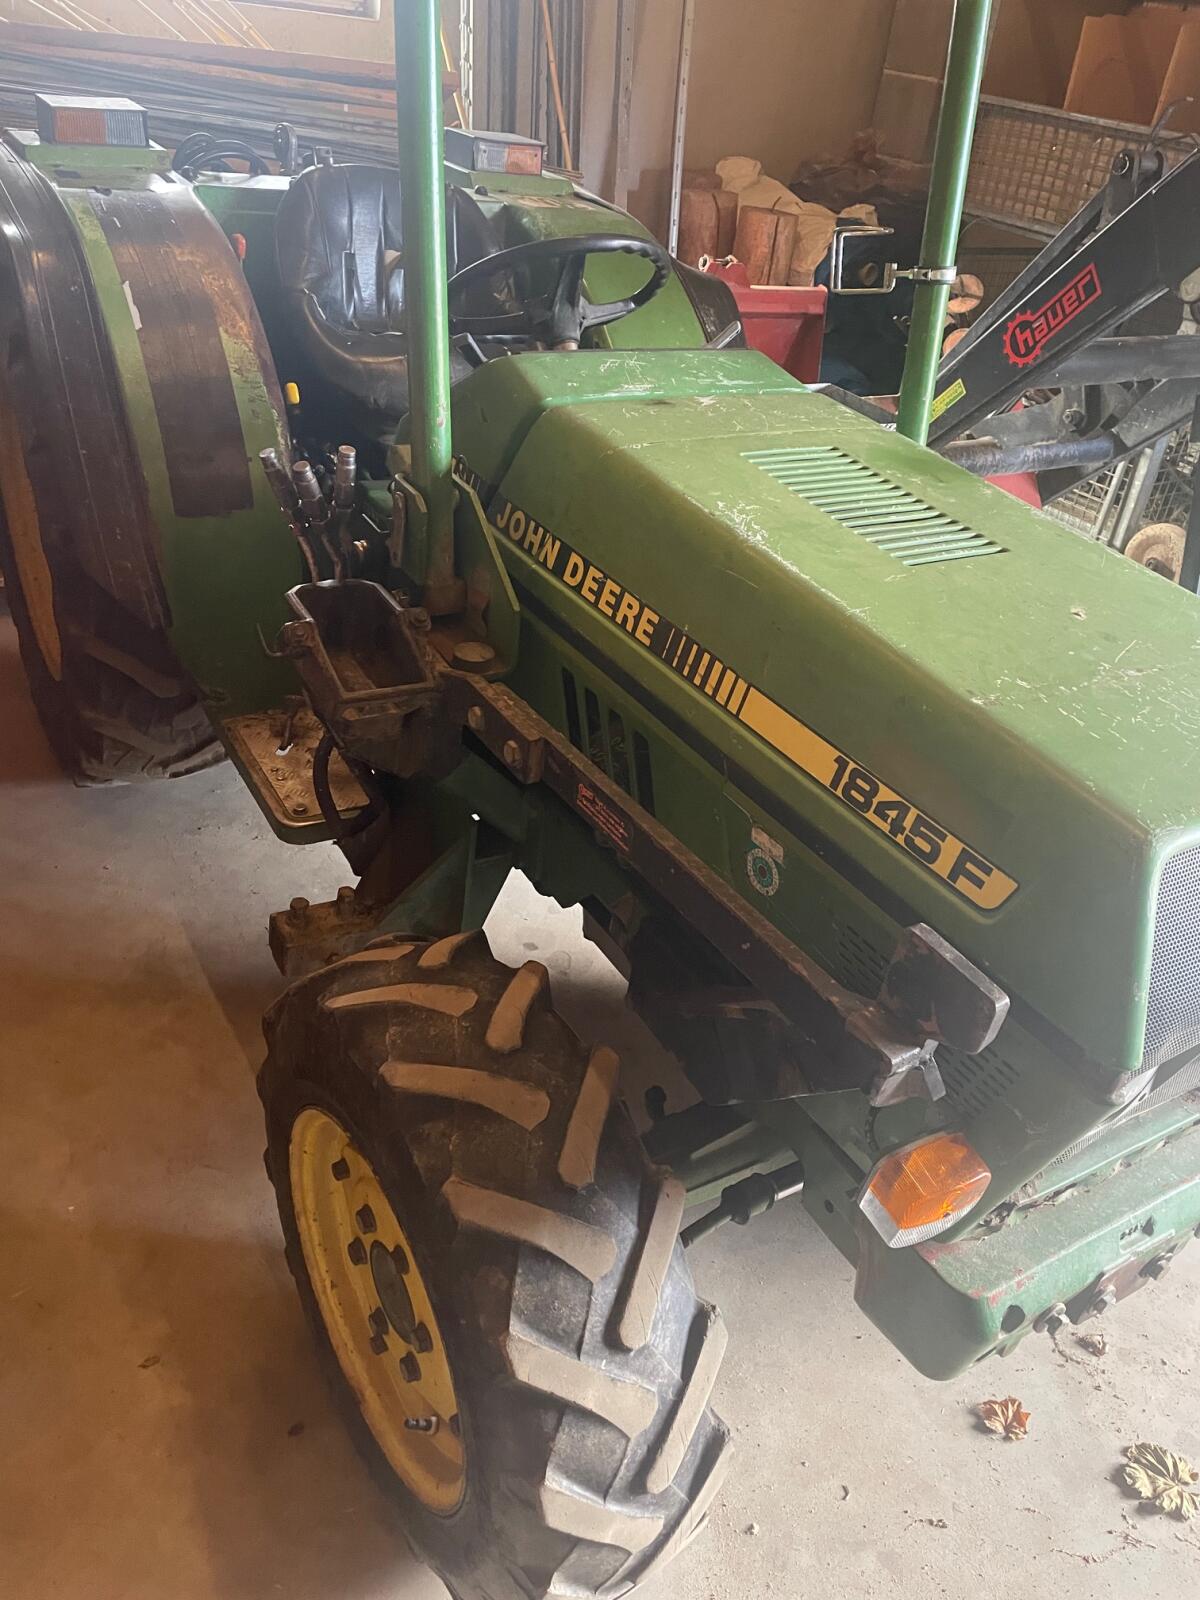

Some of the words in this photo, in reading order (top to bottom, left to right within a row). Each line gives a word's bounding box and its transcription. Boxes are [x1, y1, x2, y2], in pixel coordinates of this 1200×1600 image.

[1014, 273, 1092, 355] hauer
[496, 502, 561, 570] JOHN
[562, 551, 660, 647] DEERE
[829, 754, 949, 865] 1845
[947, 847, 994, 890] F
